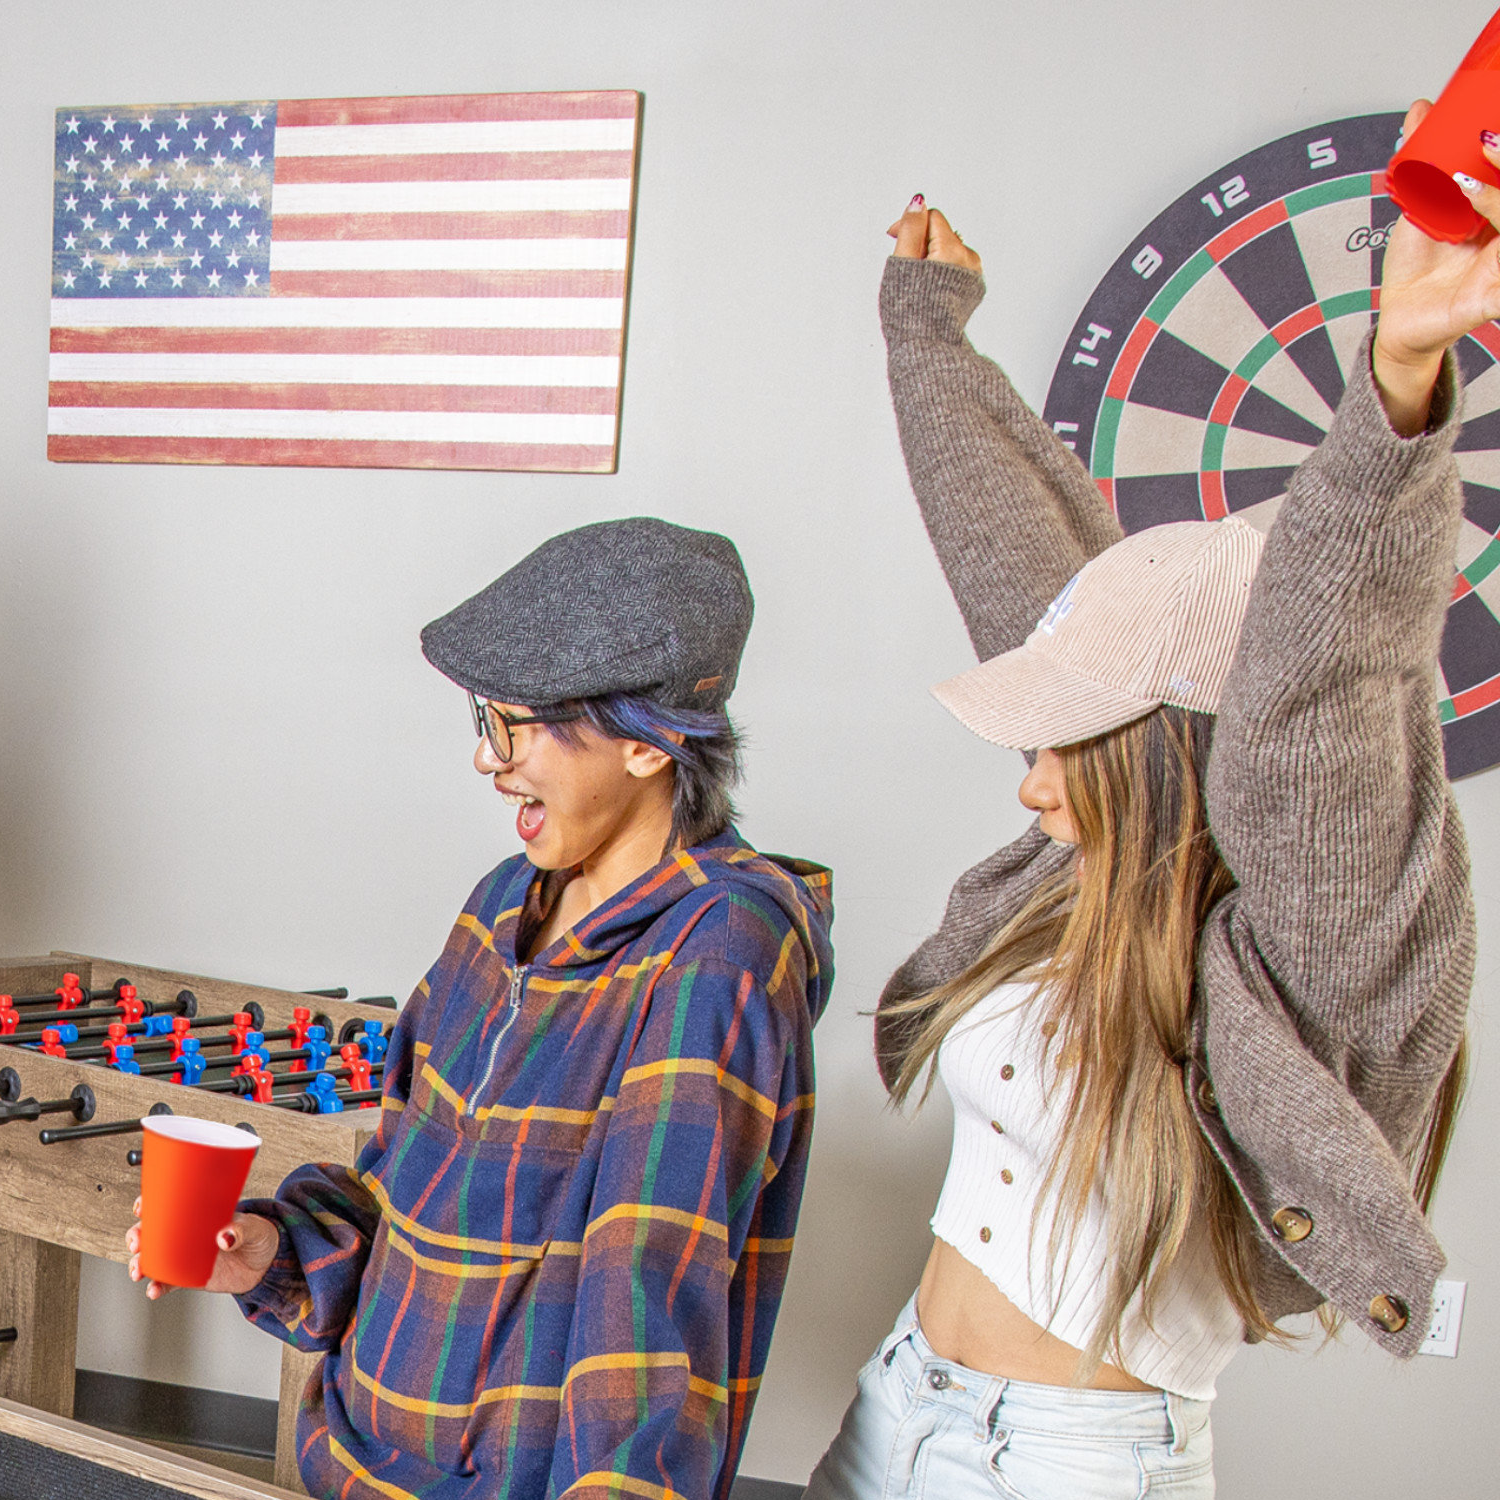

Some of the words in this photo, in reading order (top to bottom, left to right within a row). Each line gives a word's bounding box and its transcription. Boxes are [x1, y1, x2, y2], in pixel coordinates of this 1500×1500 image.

[1306, 137, 1338, 170] 5
[1200, 174, 1251, 218] 12
[1130, 243, 1164, 280] 9
[1071, 321, 1113, 368] 14
